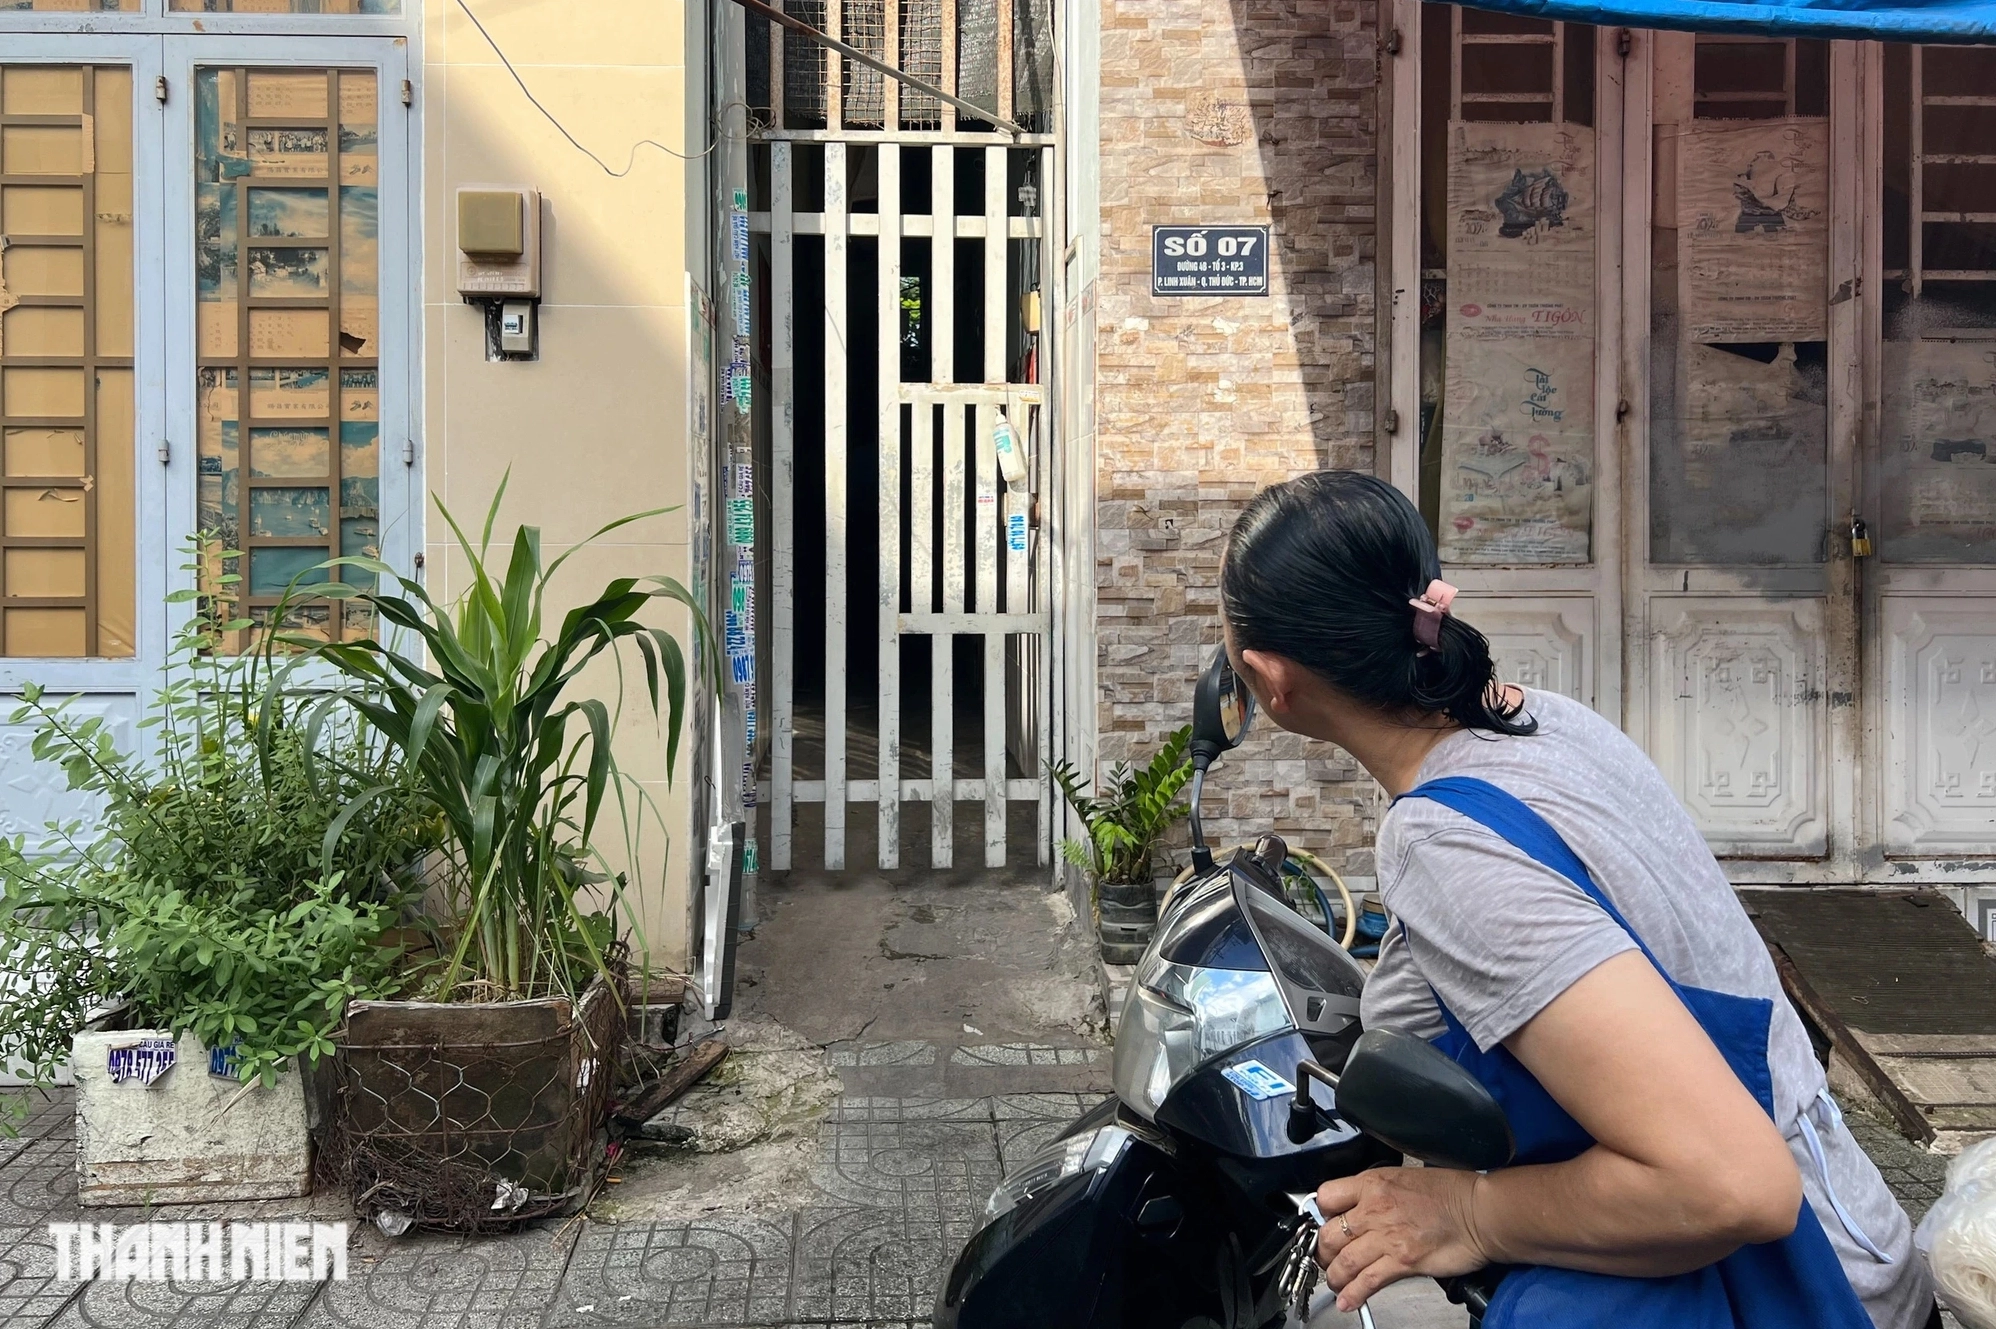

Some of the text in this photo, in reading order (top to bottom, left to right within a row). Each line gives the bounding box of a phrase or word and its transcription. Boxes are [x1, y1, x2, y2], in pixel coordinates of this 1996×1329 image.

[1164, 230, 1257, 256] SỐ 07
[1177, 260, 1198, 271] ĐƯỜNG
[1199, 262, 1207, 271] 4B
[1221, 262, 1226, 271] 3
[1158, 277, 1163, 286] P.
[1164, 277, 1178, 286] LINH
[1179, 275, 1196, 286] XUÂN
[1201, 277, 1207, 287] Q.
[1209, 274, 1220, 286] THỦ
[1221, 274, 1234, 286] ĐỨC
[1239, 277, 1247, 286] TP.
[1248, 277, 1262, 286] HCM
[1532, 308, 1587, 326] TIGÔN
